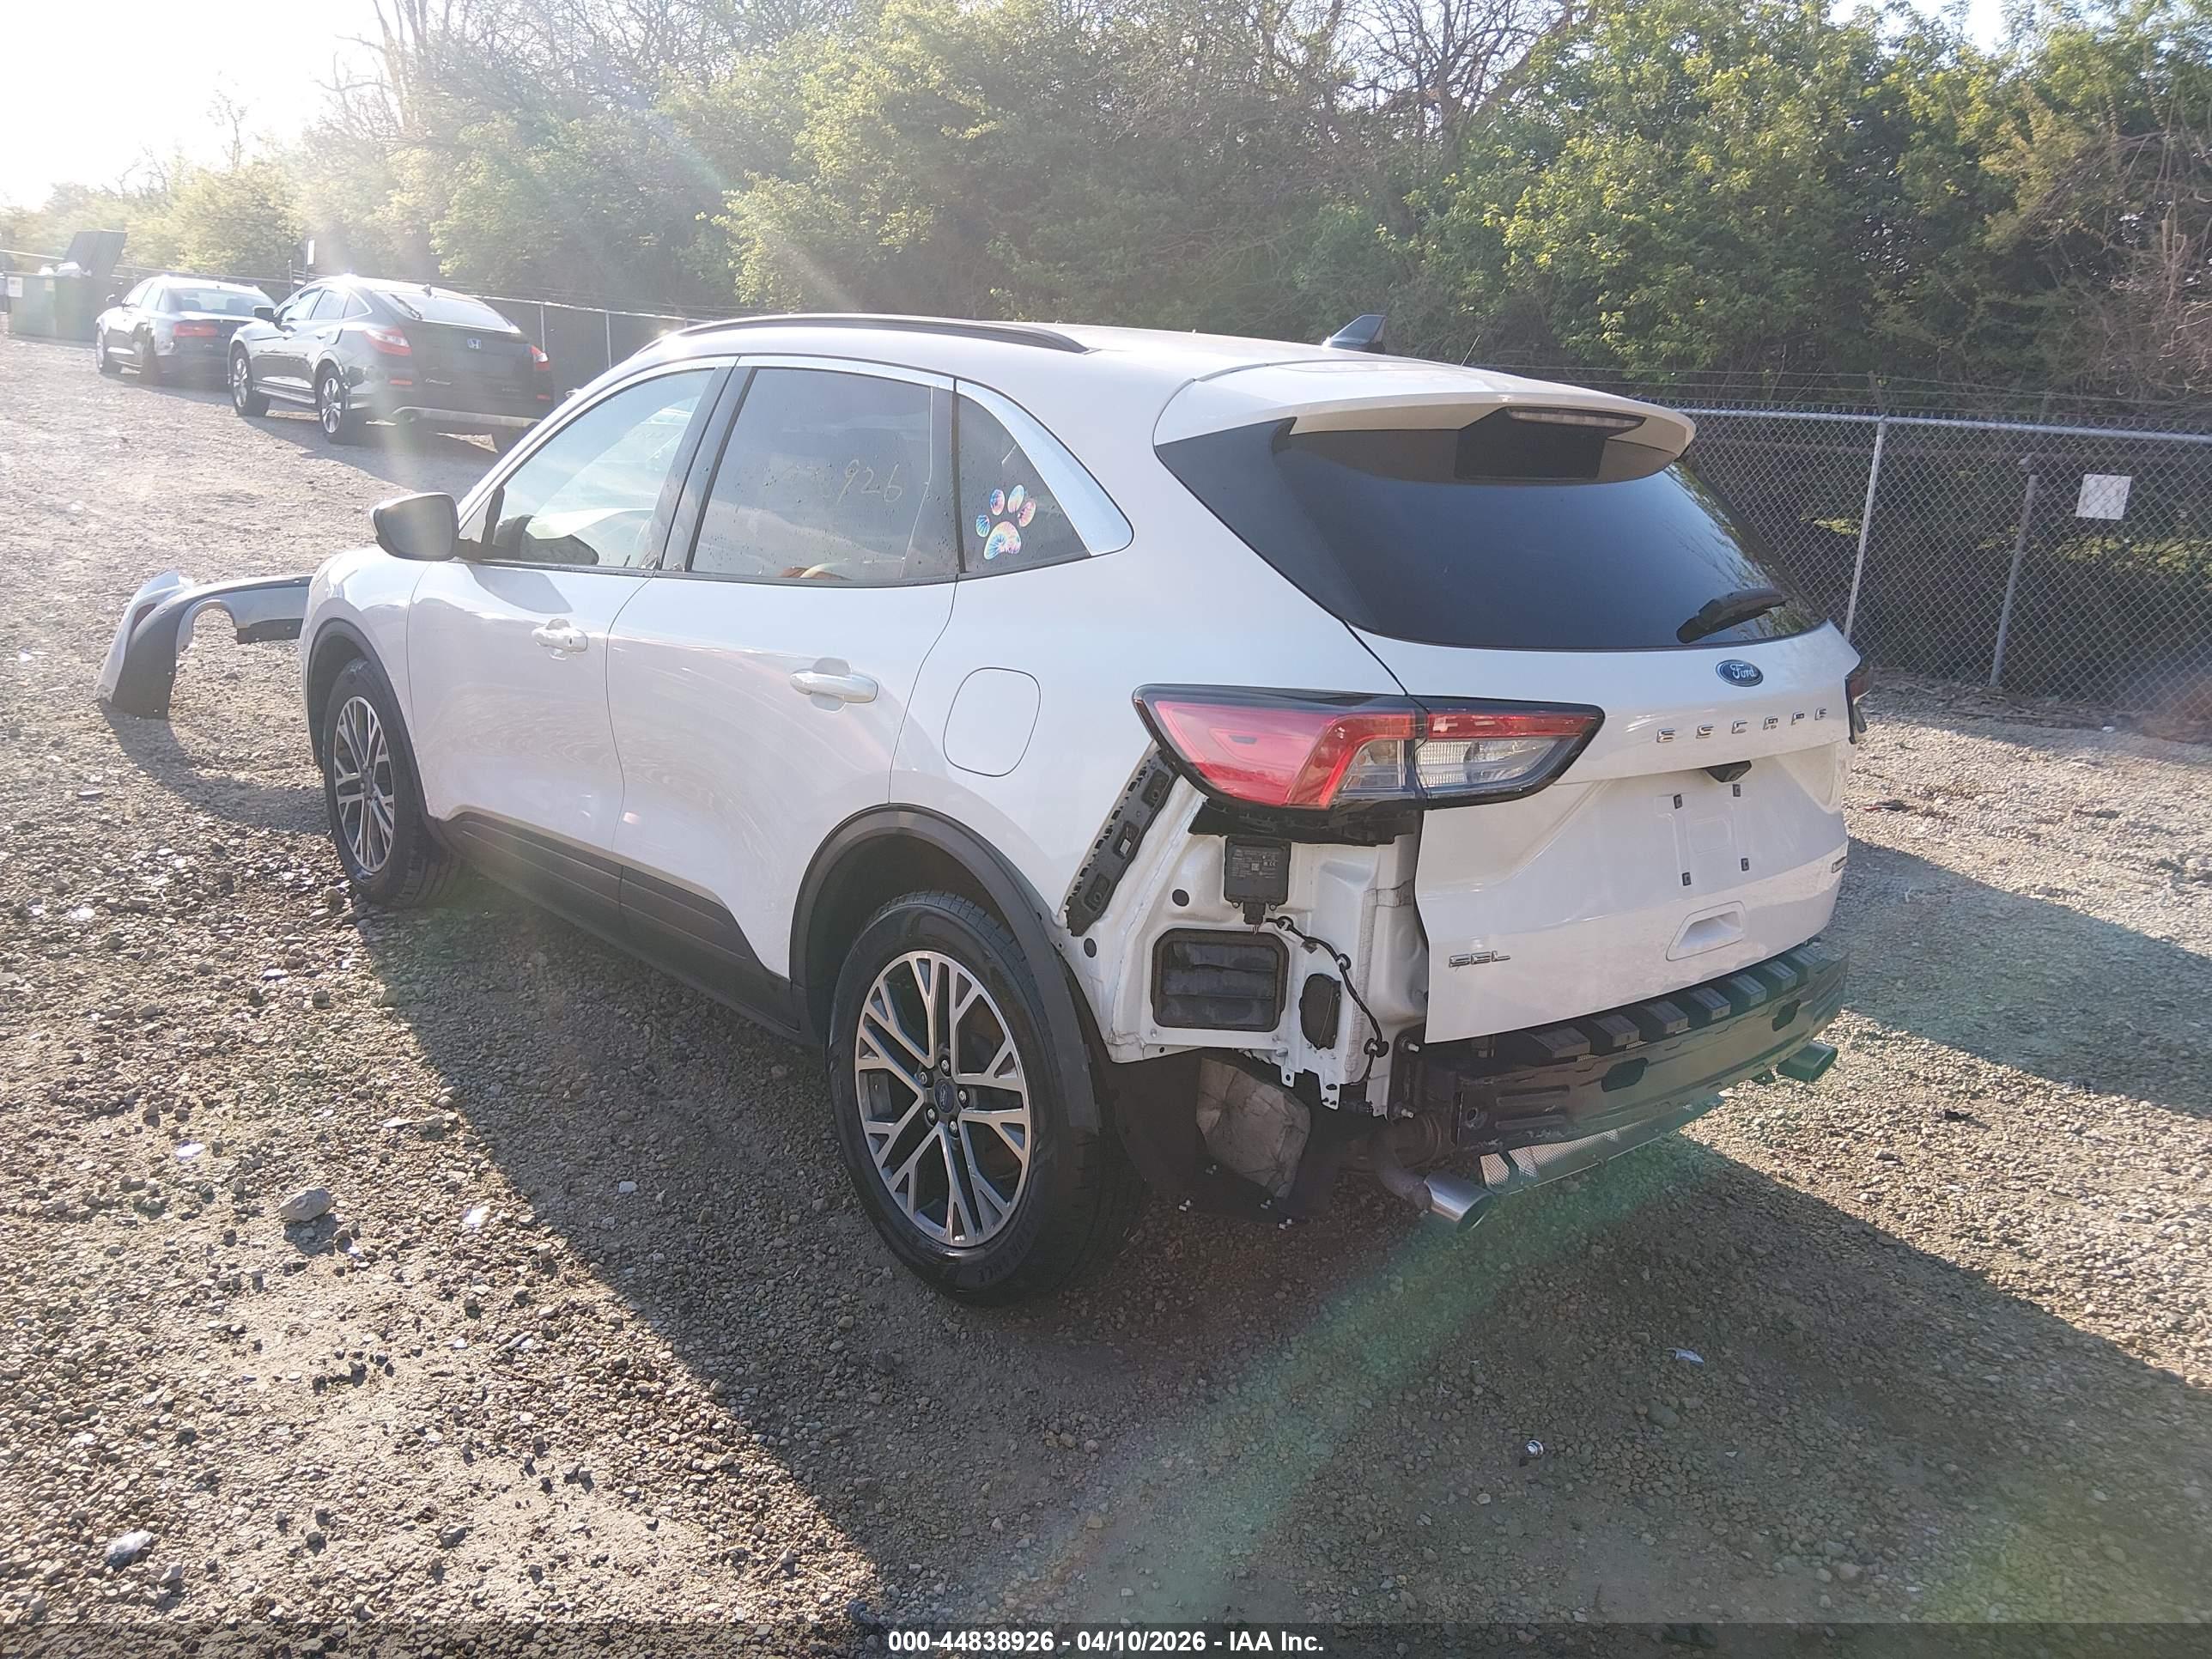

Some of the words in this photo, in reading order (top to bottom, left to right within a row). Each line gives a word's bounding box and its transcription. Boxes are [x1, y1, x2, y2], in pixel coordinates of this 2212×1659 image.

[836, 459, 902, 505] 926
[1656, 707, 1827, 743] ESCAPE
[1449, 950, 1511, 969] SEL
